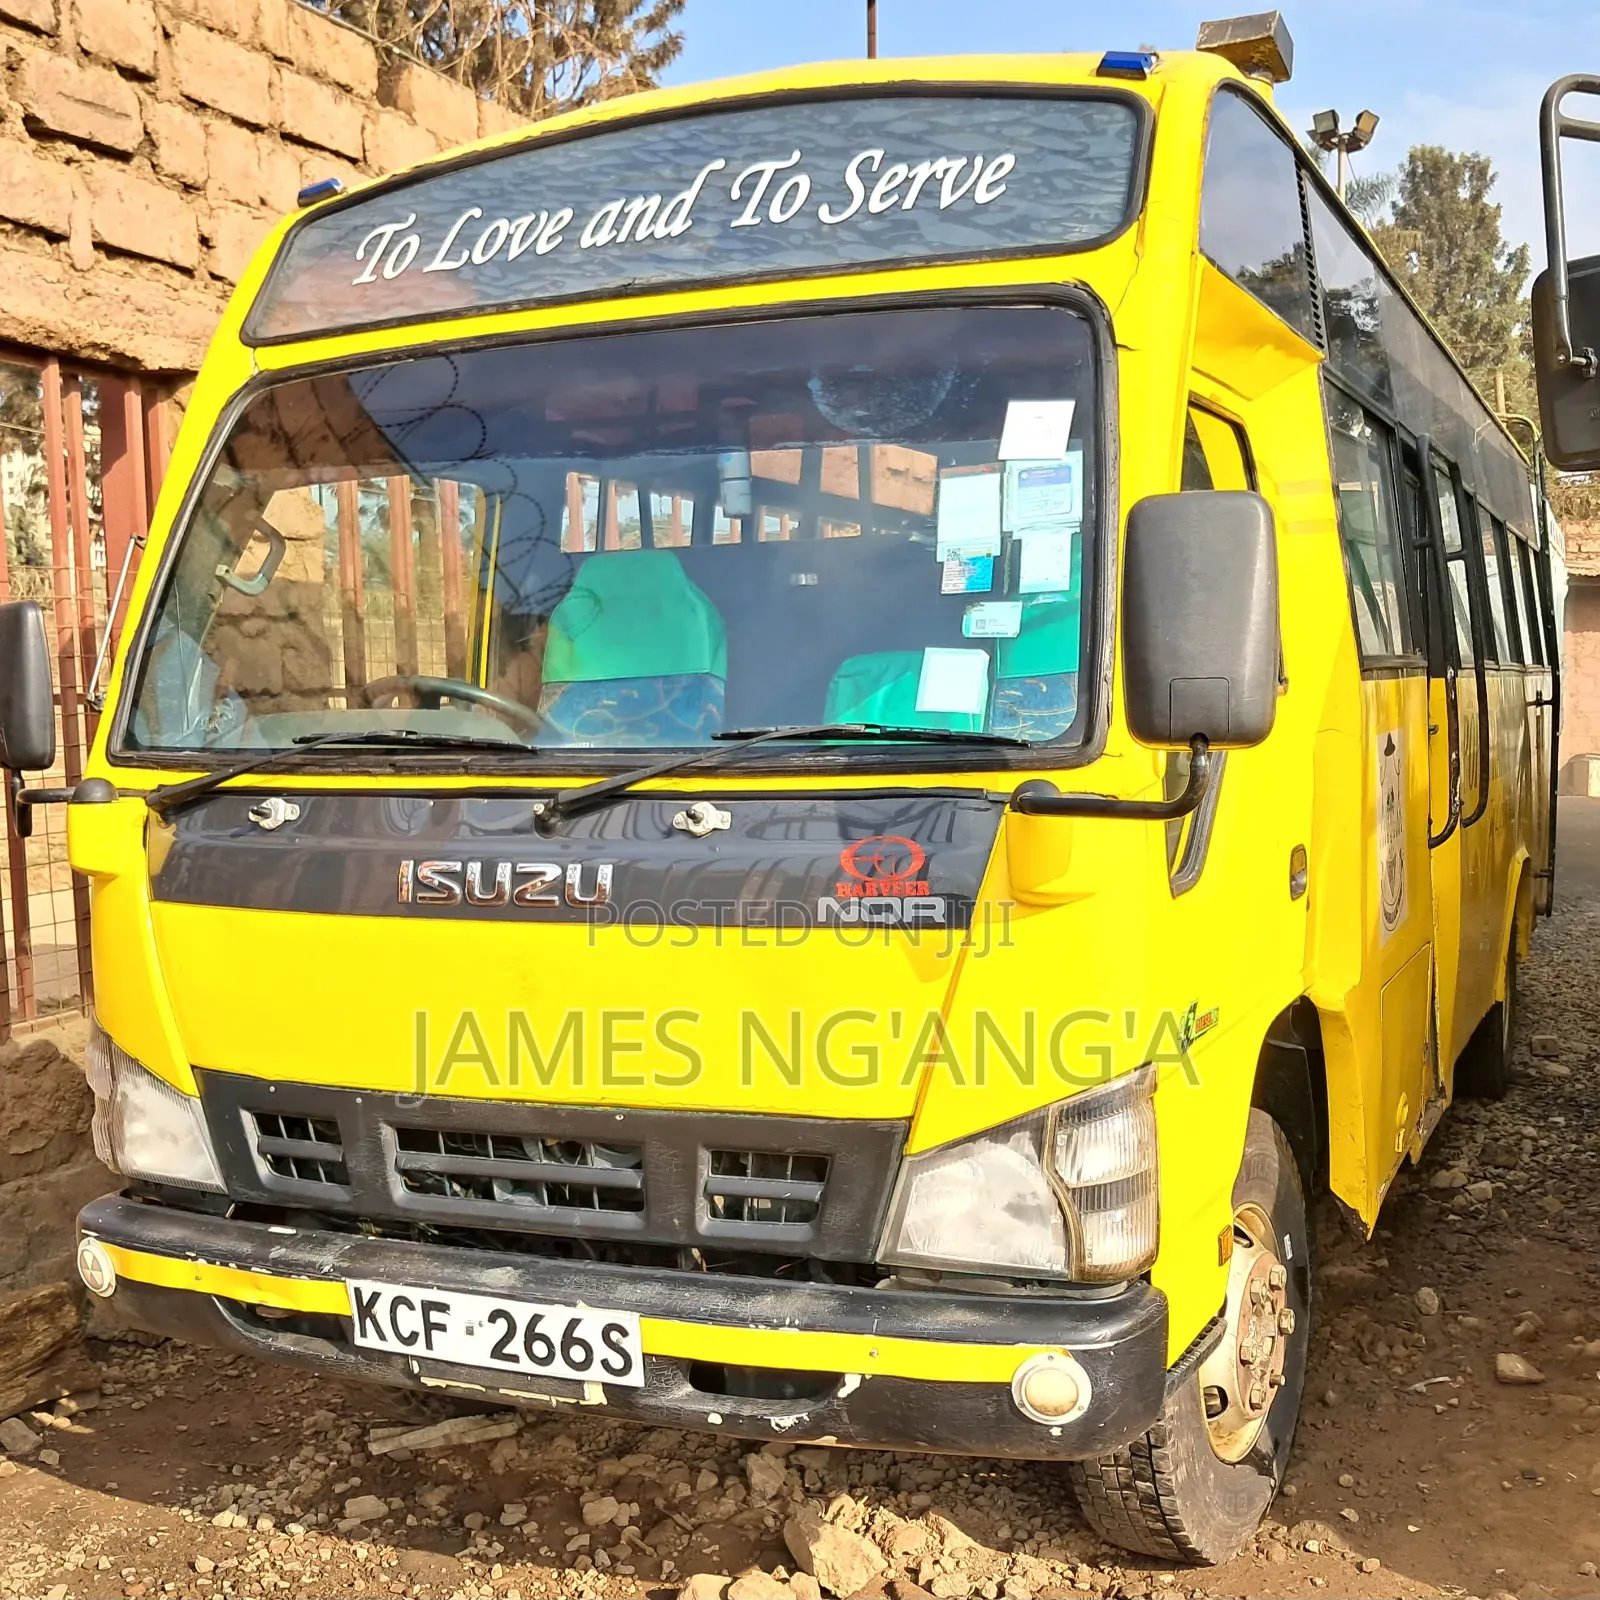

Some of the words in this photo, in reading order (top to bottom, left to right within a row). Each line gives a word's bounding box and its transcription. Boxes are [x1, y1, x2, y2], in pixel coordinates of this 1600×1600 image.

[351, 213, 420, 287] To
[423, 206, 564, 273] Love
[580, 158, 727, 250] and
[730, 150, 811, 229] To
[818, 148, 1017, 226] Serve
[398, 859, 613, 908] ISUZU
[817, 896, 946, 925] NQR
[354, 1286, 451, 1351] KCF
[487, 1308, 633, 1377] 266S
